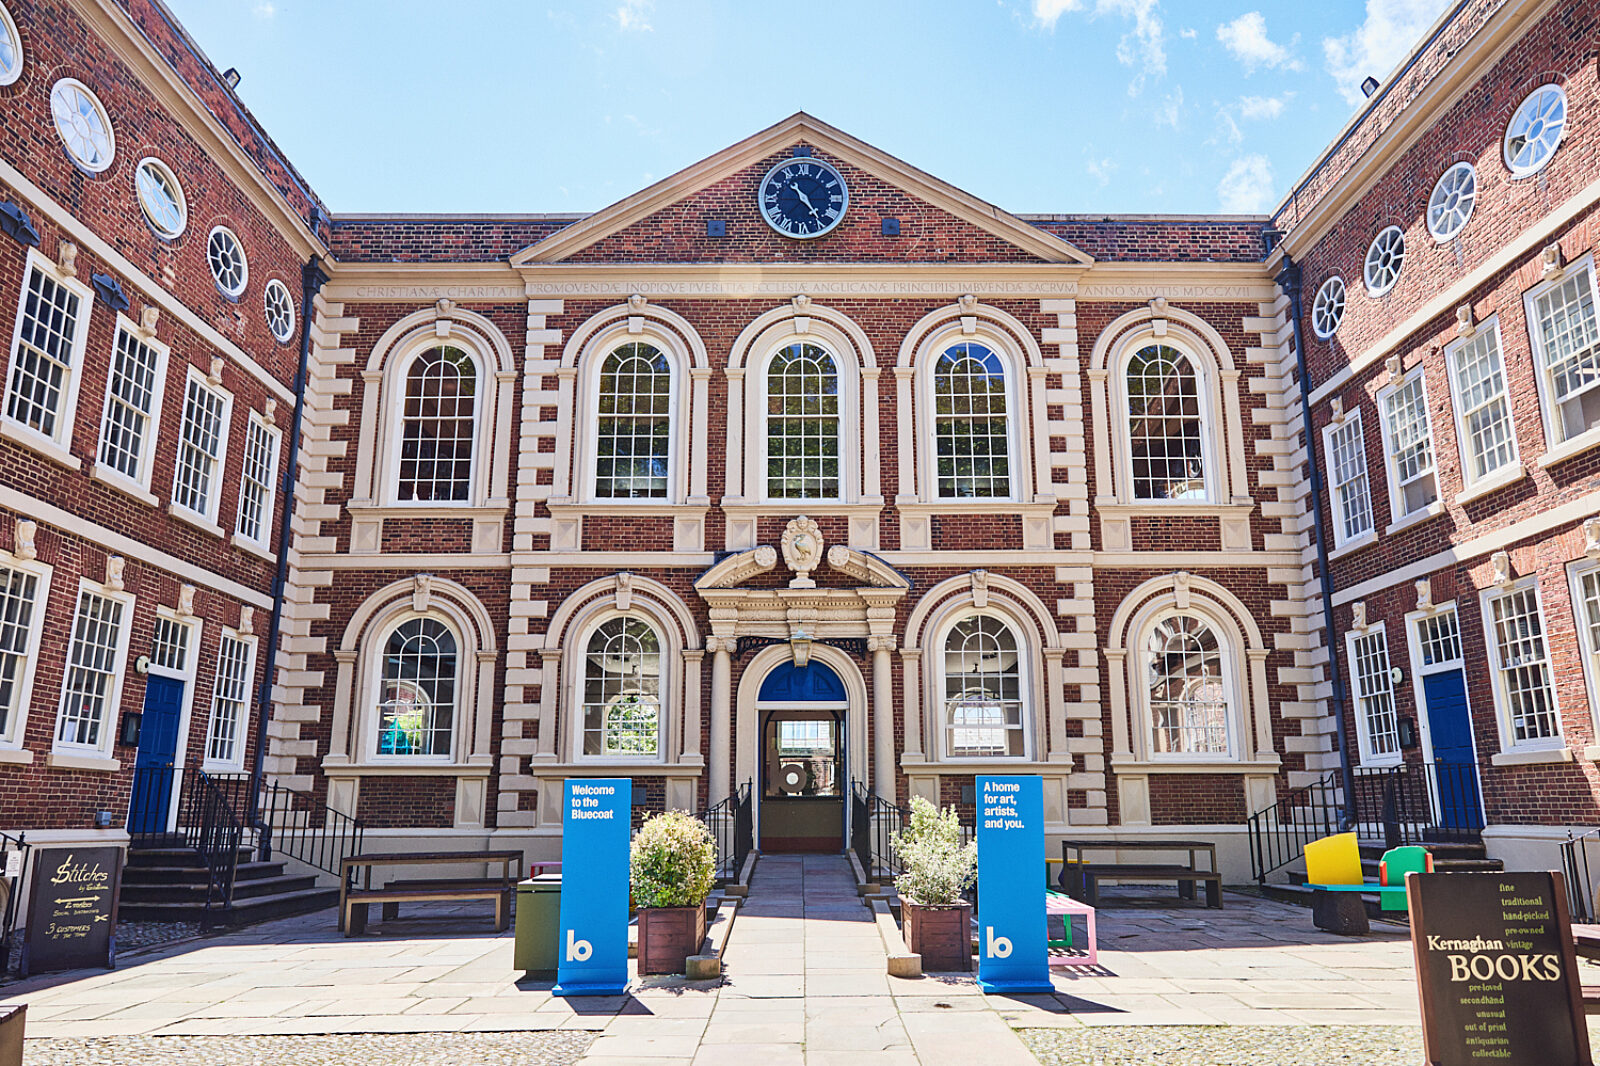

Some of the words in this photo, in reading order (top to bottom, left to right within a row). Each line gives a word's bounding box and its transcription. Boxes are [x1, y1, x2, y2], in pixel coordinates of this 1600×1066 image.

[1084, 286, 1125, 297] ANNO
[1130, 286, 1178, 297] SALVTIS
[1183, 286, 1250, 297] MDCCXVII
[571, 784, 615, 796] Welcome
[984, 781, 991, 792] A
[992, 781, 1020, 792] home
[571, 797, 581, 807] to
[582, 797, 599, 807] the
[984, 794, 998, 804] for
[999, 794, 1017, 806] art,
[571, 808, 614, 820] Bluecoat
[984, 806, 1018, 818] artists,
[984, 818, 1003, 828] and
[1004, 818, 1025, 830] you.
[1499, 883, 1515, 892] fine
[1501, 896, 1543, 906] traditional
[1503, 911, 1549, 922] hand-picked
[45, 922, 56, 935] 3
[1505, 925, 1544, 936] pre-owned
[1427, 935, 1504, 953] Kernaghan
[1505, 940, 1533, 950] vintage
[1447, 954, 1561, 982] BOOKS
[1468, 983, 1503, 992] pre-loved
[1460, 995, 1505, 1004] secondhand
[1476, 1009, 1506, 1018] unusual
[1464, 1023, 1478, 1032] out
[1479, 1022, 1487, 1031] of
[1488, 1022, 1507, 1033] print
[1466, 1036, 1509, 1046] antiquarian
[1472, 1049, 1512, 1058] collectable
